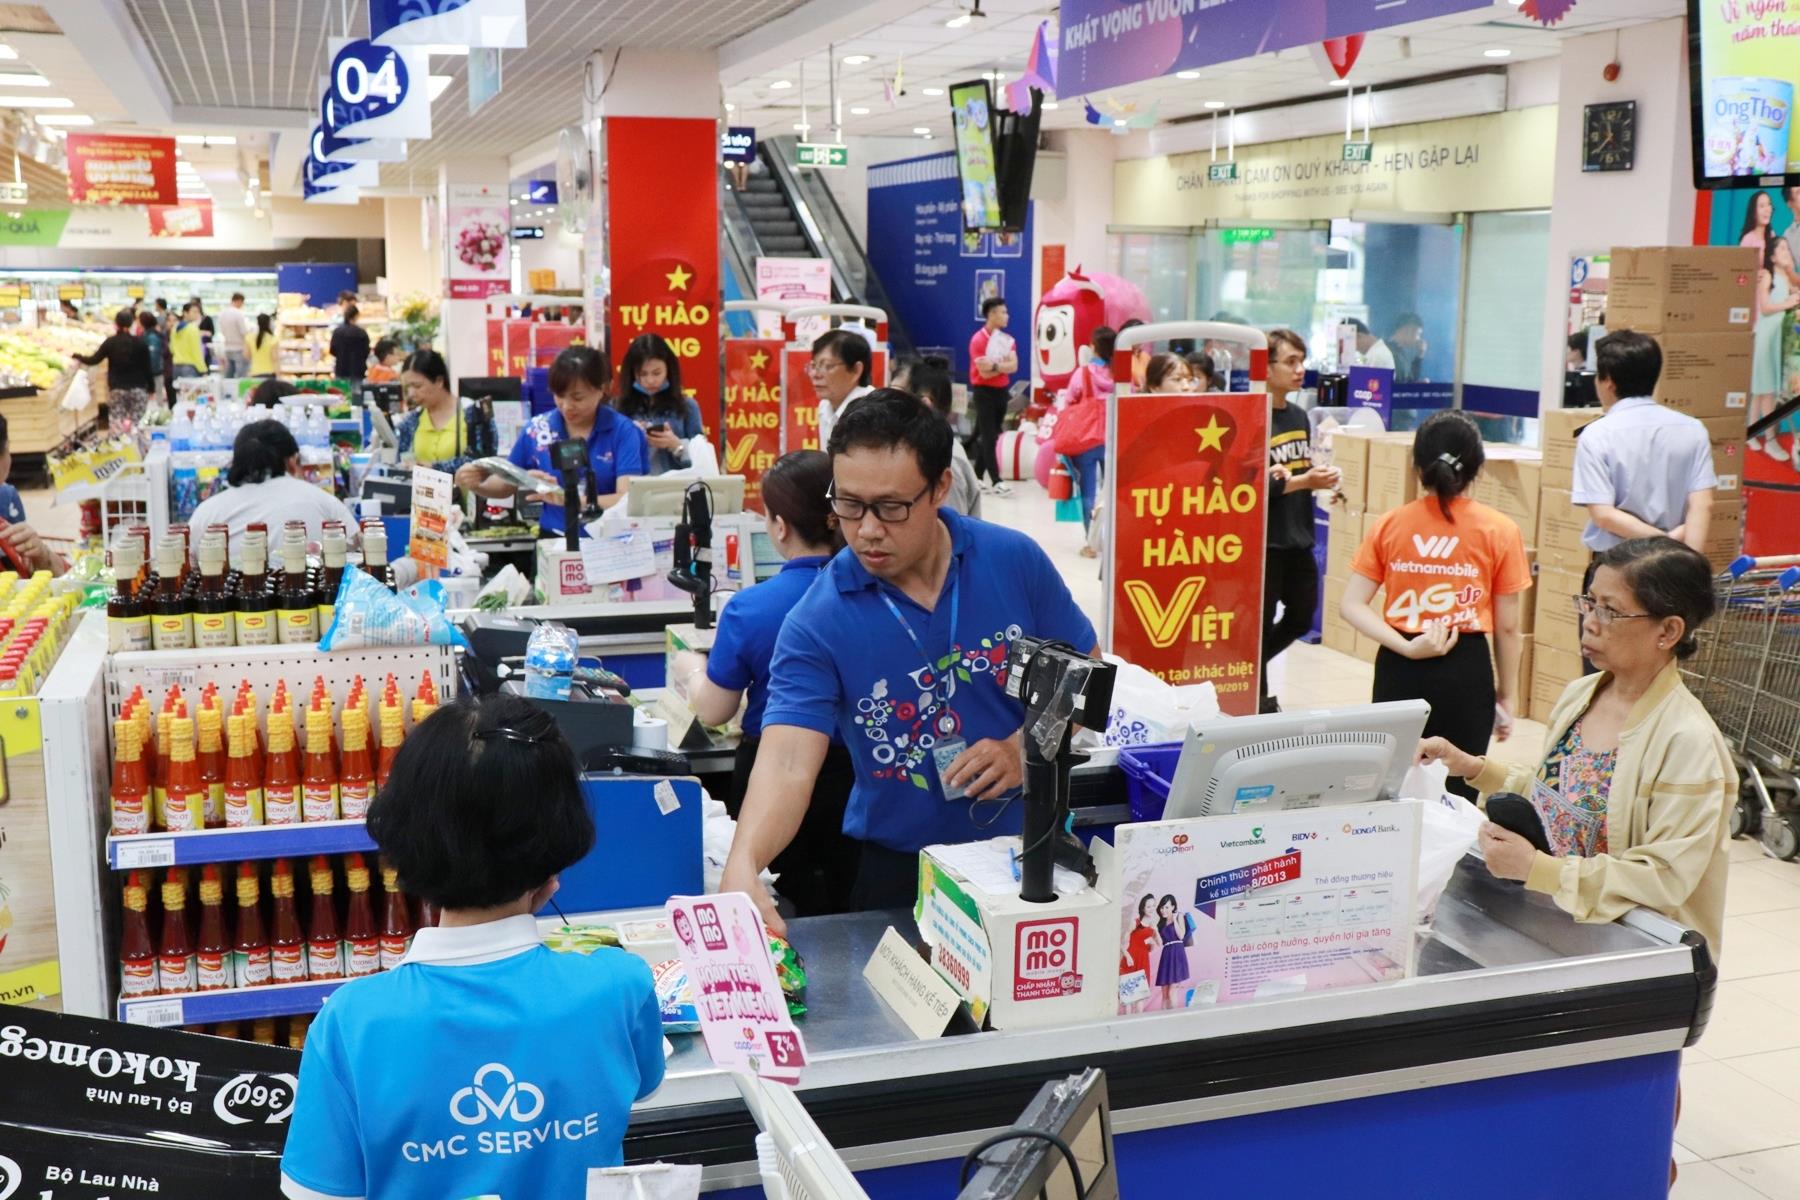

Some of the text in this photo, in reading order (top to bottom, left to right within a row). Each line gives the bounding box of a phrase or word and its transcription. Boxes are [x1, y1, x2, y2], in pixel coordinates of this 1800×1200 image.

[1065, 14, 1099, 51] KHÁT
[1101, 6, 1143, 43] VỌNG
[337, 56, 401, 104] 04
[1345, 145, 1367, 160] EXIT
[1384, 152, 1414, 174] HẸN
[1456, 144, 1479, 168] LẠI
[1211, 165, 1232, 180] EXIT
[619, 300, 710, 331] TỰ HÀO
[1132, 477, 1257, 526] TỰ HÀO
[1143, 528, 1243, 568] HÀNG
[1390, 559, 1479, 578] vietnamobile
[1123, 576, 1235, 650] VIỆT
[1386, 582, 1456, 629] 4G
[1169, 666, 1190, 685] tạo
[1194, 663, 1225, 679] khác
[1228, 662, 1254, 680] biệt
[1220, 838, 1266, 848] Vietcombank
[1292, 833, 1310, 841] BIDV
[1200, 856, 1297, 889] Chính thức phát hành
[1251, 870, 1287, 889] 8/2013
[696, 908, 717, 925] mo
[702, 926, 722, 942] mo
[1027, 928, 1067, 949] mo
[1371, 926, 1391, 938] tăng
[938, 943, 970, 992] 38360999
[1026, 949, 1066, 970] mo
[889, 950, 910, 980] KHÁCH
[908, 968, 927, 999] HÀNG
[923, 986, 938, 1011] KẾ
[932, 996, 949, 1019] TIẾP
[1016, 979, 1056, 991] CHẤP NHẬN
[1016, 985, 1060, 999] THANH TOÁN
[771, 1034, 795, 1064] 3%
[86, 1087, 193, 1115] Bộ Lau Nhà
[402, 1112, 599, 1162] CMC SERVICE
[46, 1165, 160, 1192] Bộ Lau Nhà
